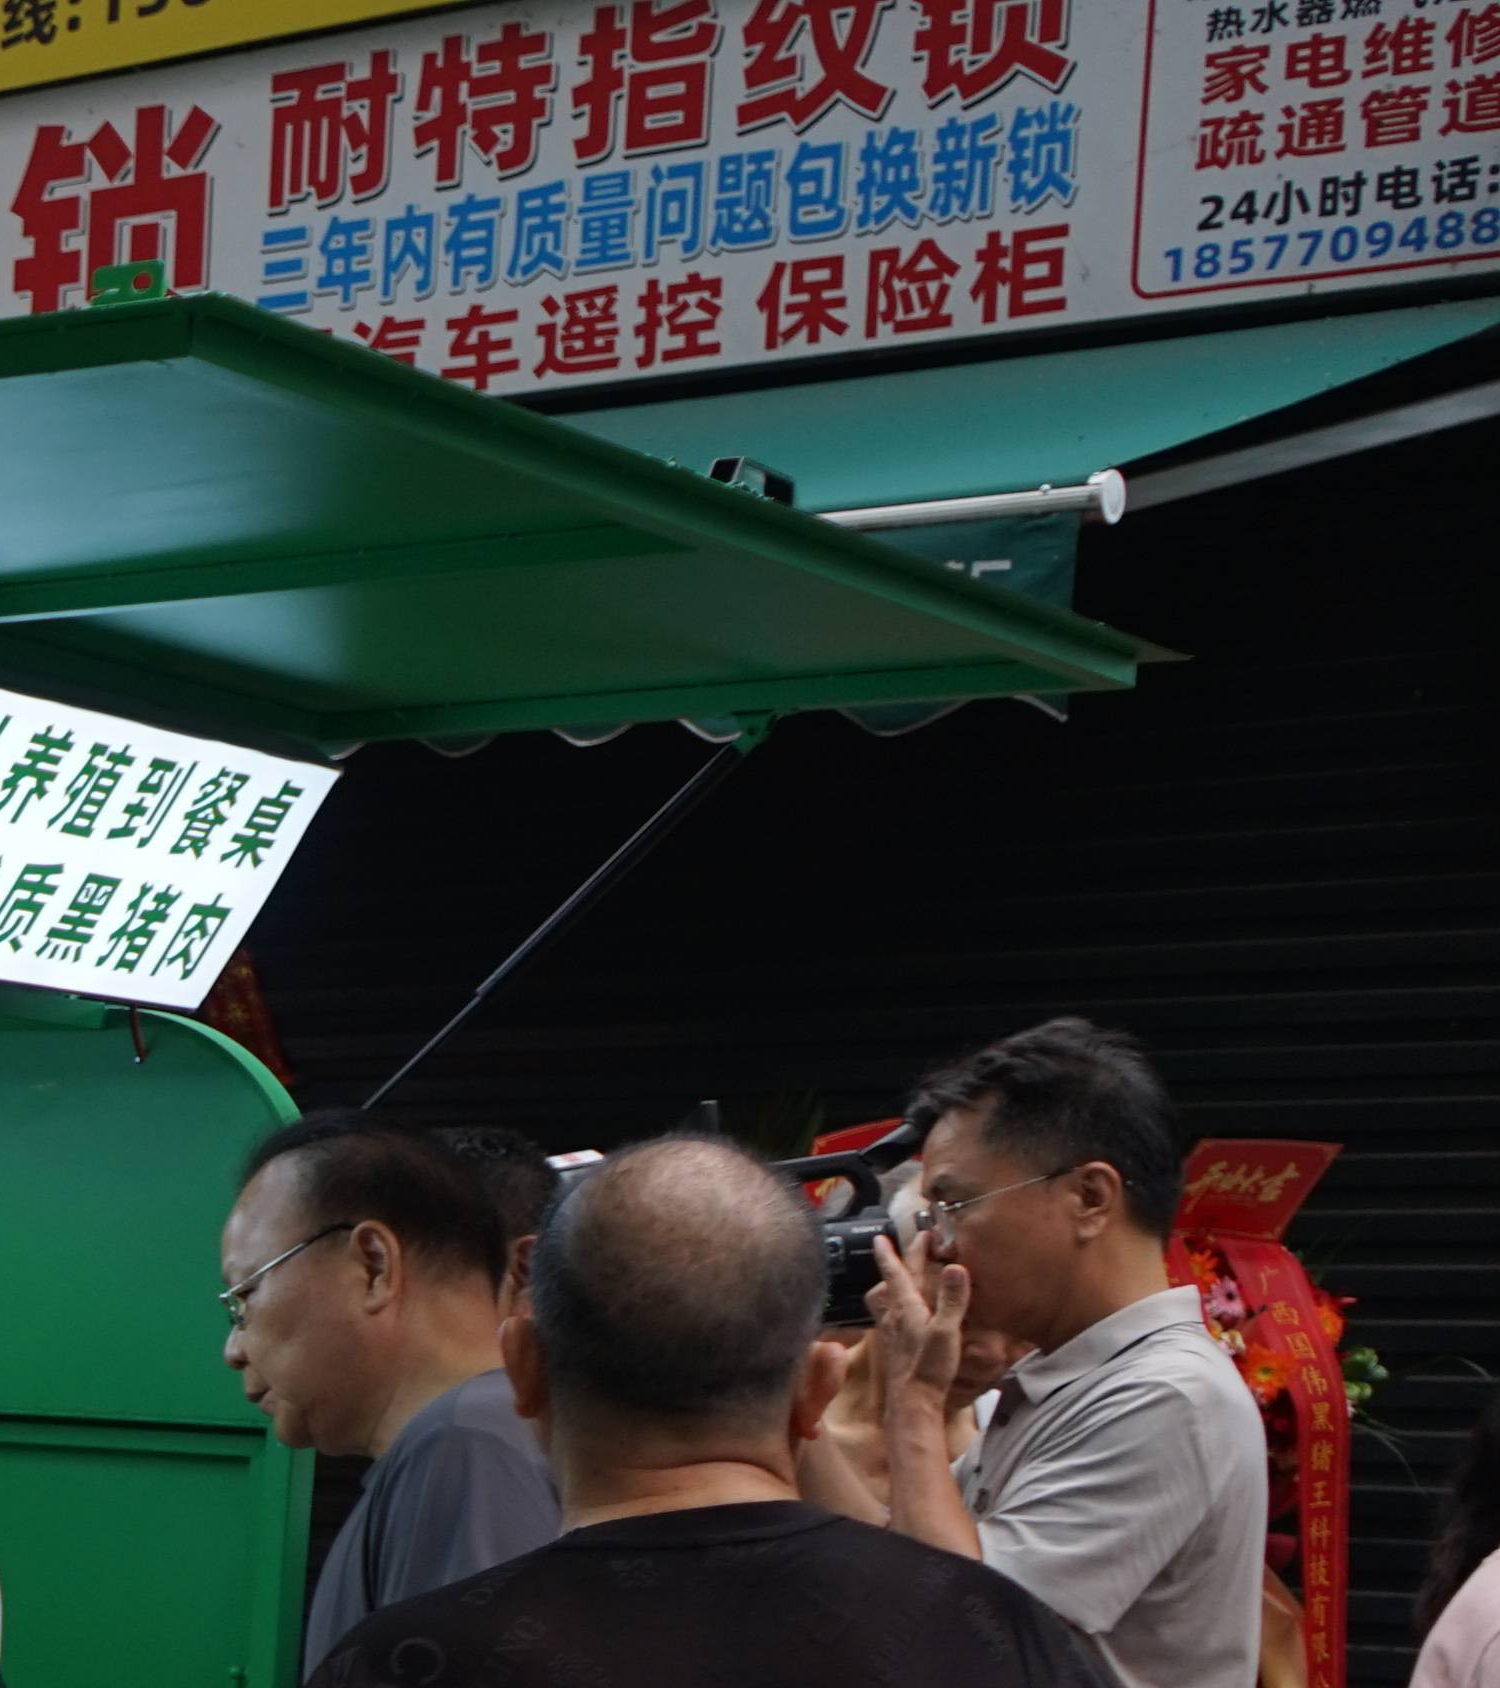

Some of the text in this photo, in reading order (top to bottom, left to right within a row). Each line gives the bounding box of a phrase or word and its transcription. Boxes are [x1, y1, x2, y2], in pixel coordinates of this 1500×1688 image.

[266, 0, 1076, 212] 耐特指纹锁
[1194, 72, 1500, 171] 疏通管道
[1201, 3, 1500, 105] 家电维修
[256, 98, 1080, 310] 三年内有质量问题包换新锁
[315, 223, 1072, 392] 汽车遥控 保险柜
